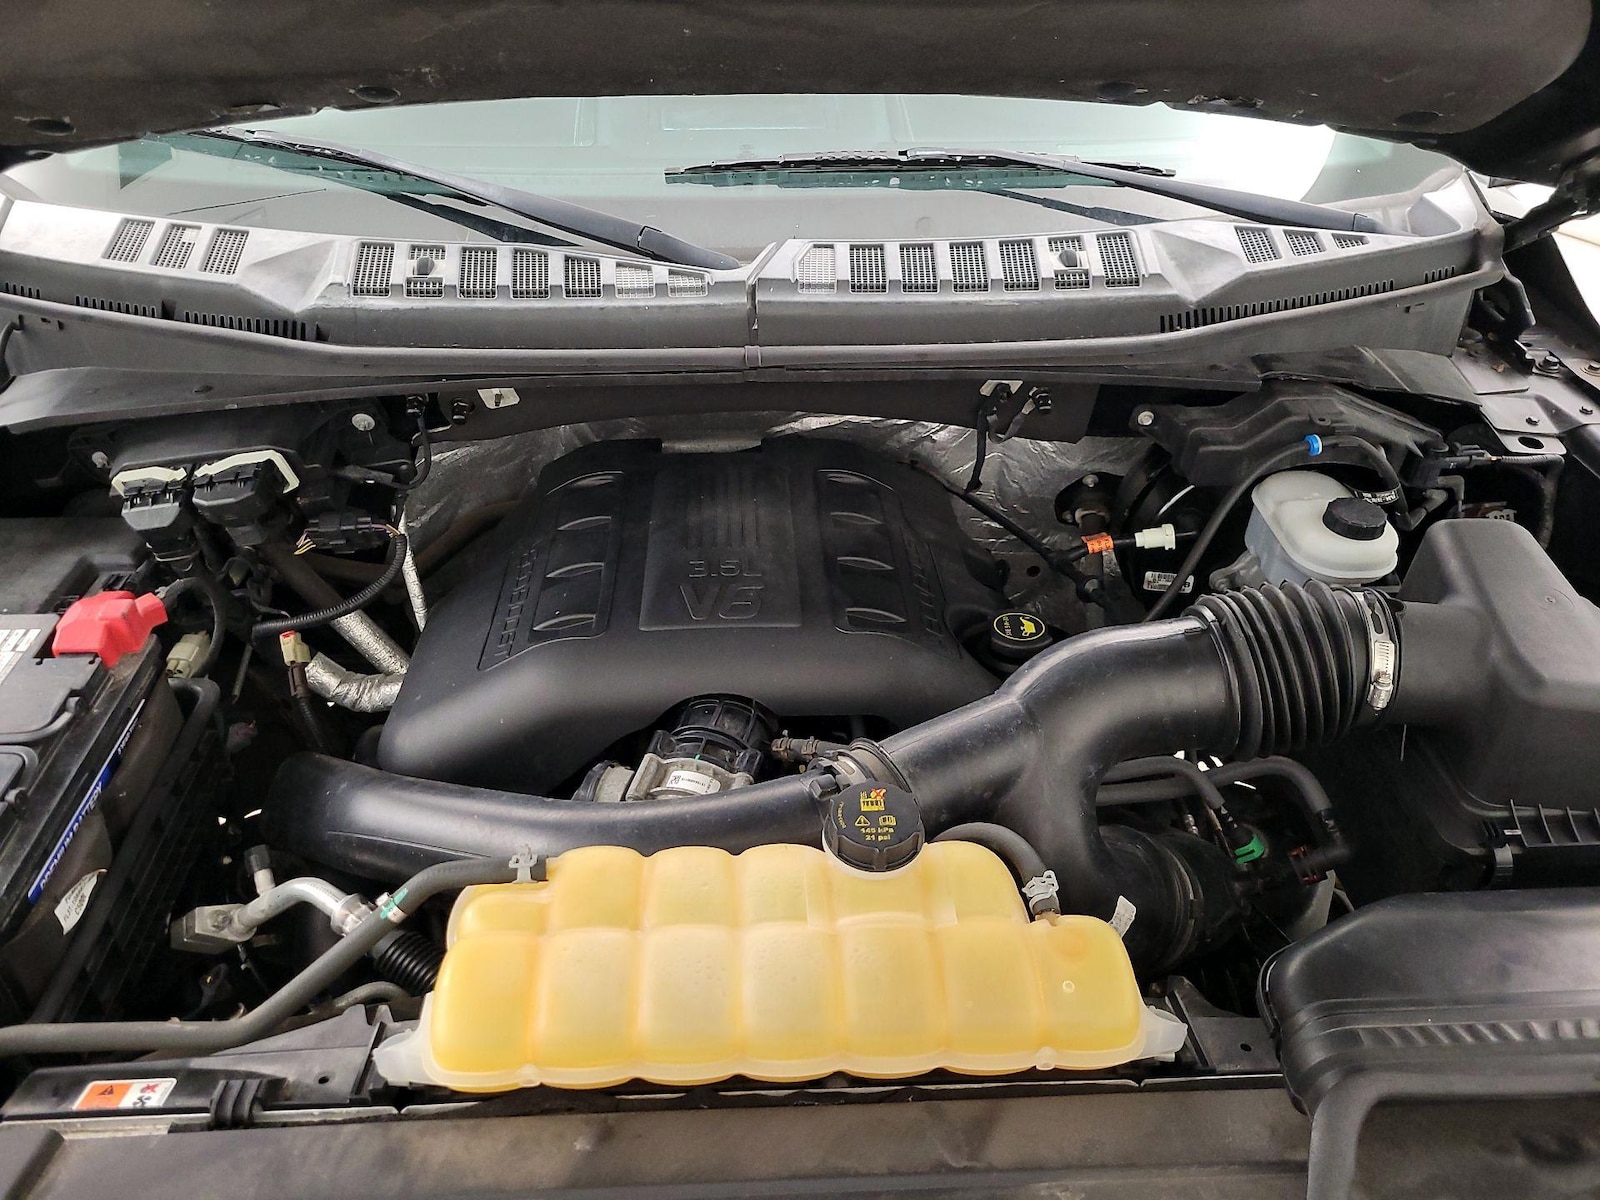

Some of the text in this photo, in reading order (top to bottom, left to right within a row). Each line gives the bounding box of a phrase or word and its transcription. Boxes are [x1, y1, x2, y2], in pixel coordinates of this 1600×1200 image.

[688, 559, 763, 578] 3.5L
[679, 583, 766, 621] V6
[877, 834, 891, 842] psi
